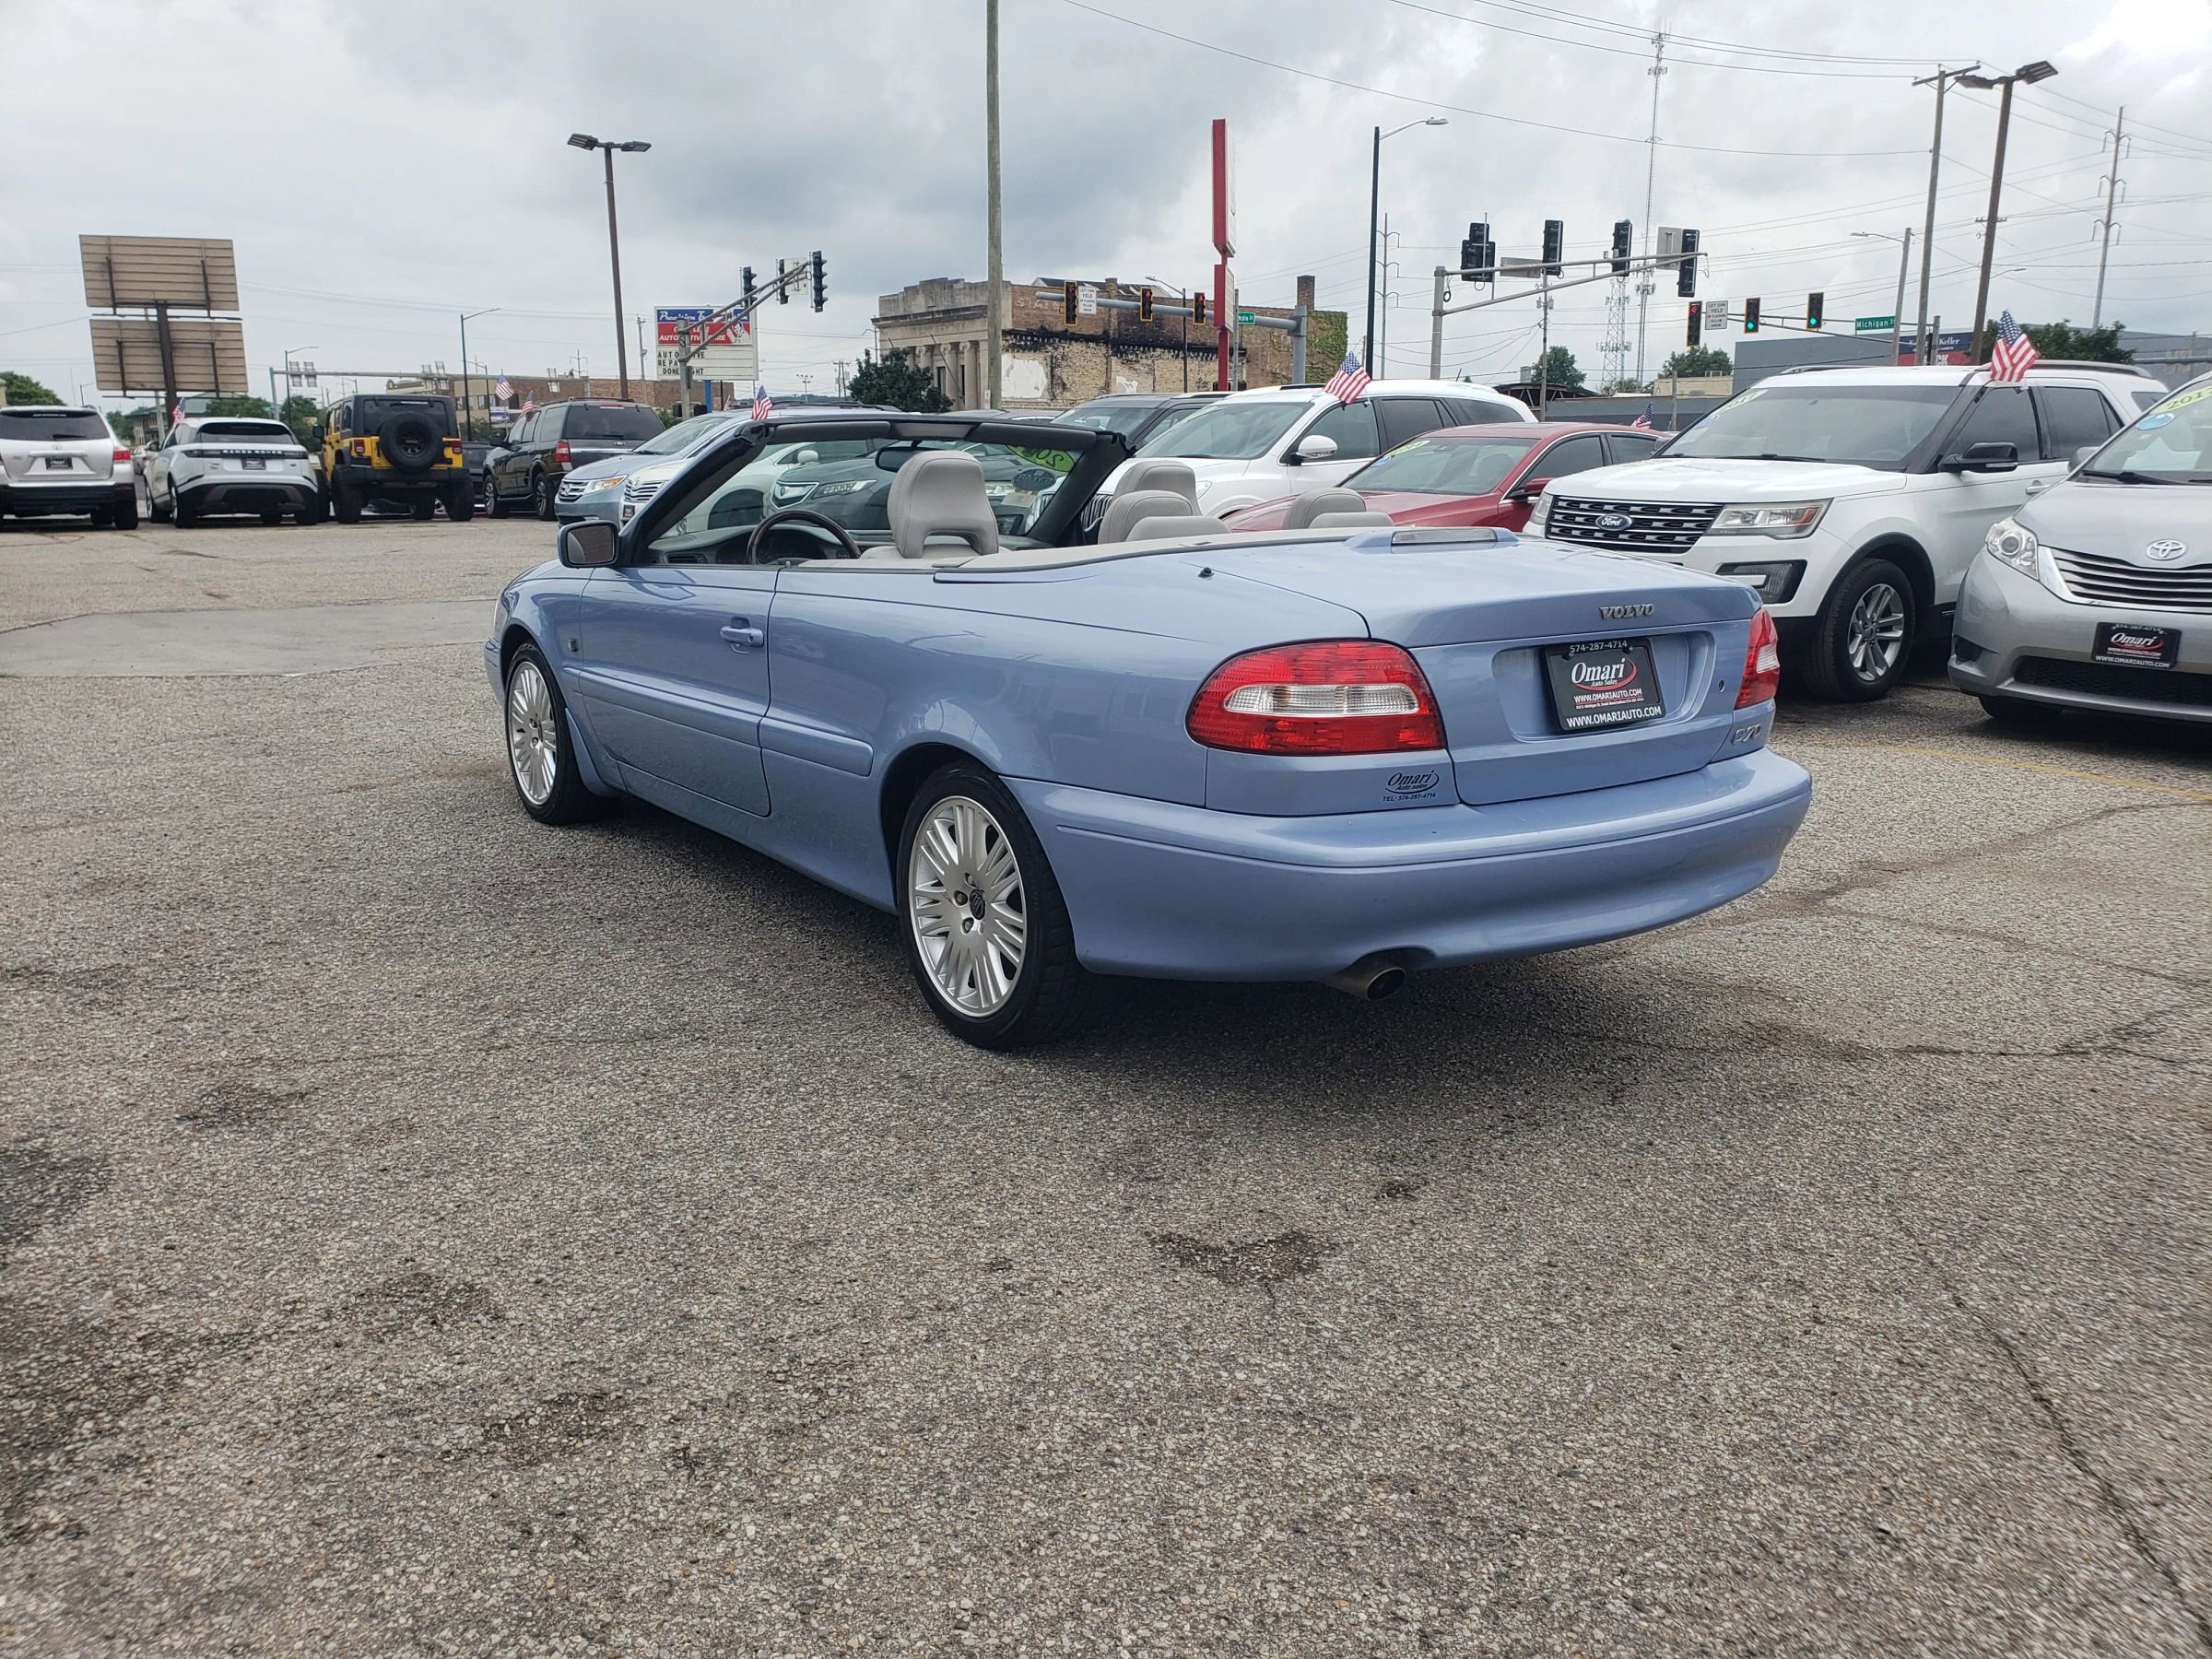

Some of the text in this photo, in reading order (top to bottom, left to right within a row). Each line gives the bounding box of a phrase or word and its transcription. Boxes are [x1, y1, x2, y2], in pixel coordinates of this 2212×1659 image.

[1599, 604, 1655, 619] VOLVO
[1570, 640, 1628, 653] 574-287-4714
[2112, 632, 2158, 646] Omari
[2095, 655, 2170, 668] WWW.OMARIAUTO.COM
[1571, 657, 1626, 684] Omari
[1573, 688, 1642, 703] WWW.OMARIAUTO.COM
[1567, 706, 1662, 728] WWW.OMARIAUTO.COM
[1387, 770, 1435, 786] Omari
[1397, 793, 1436, 801] 574-287-4714
